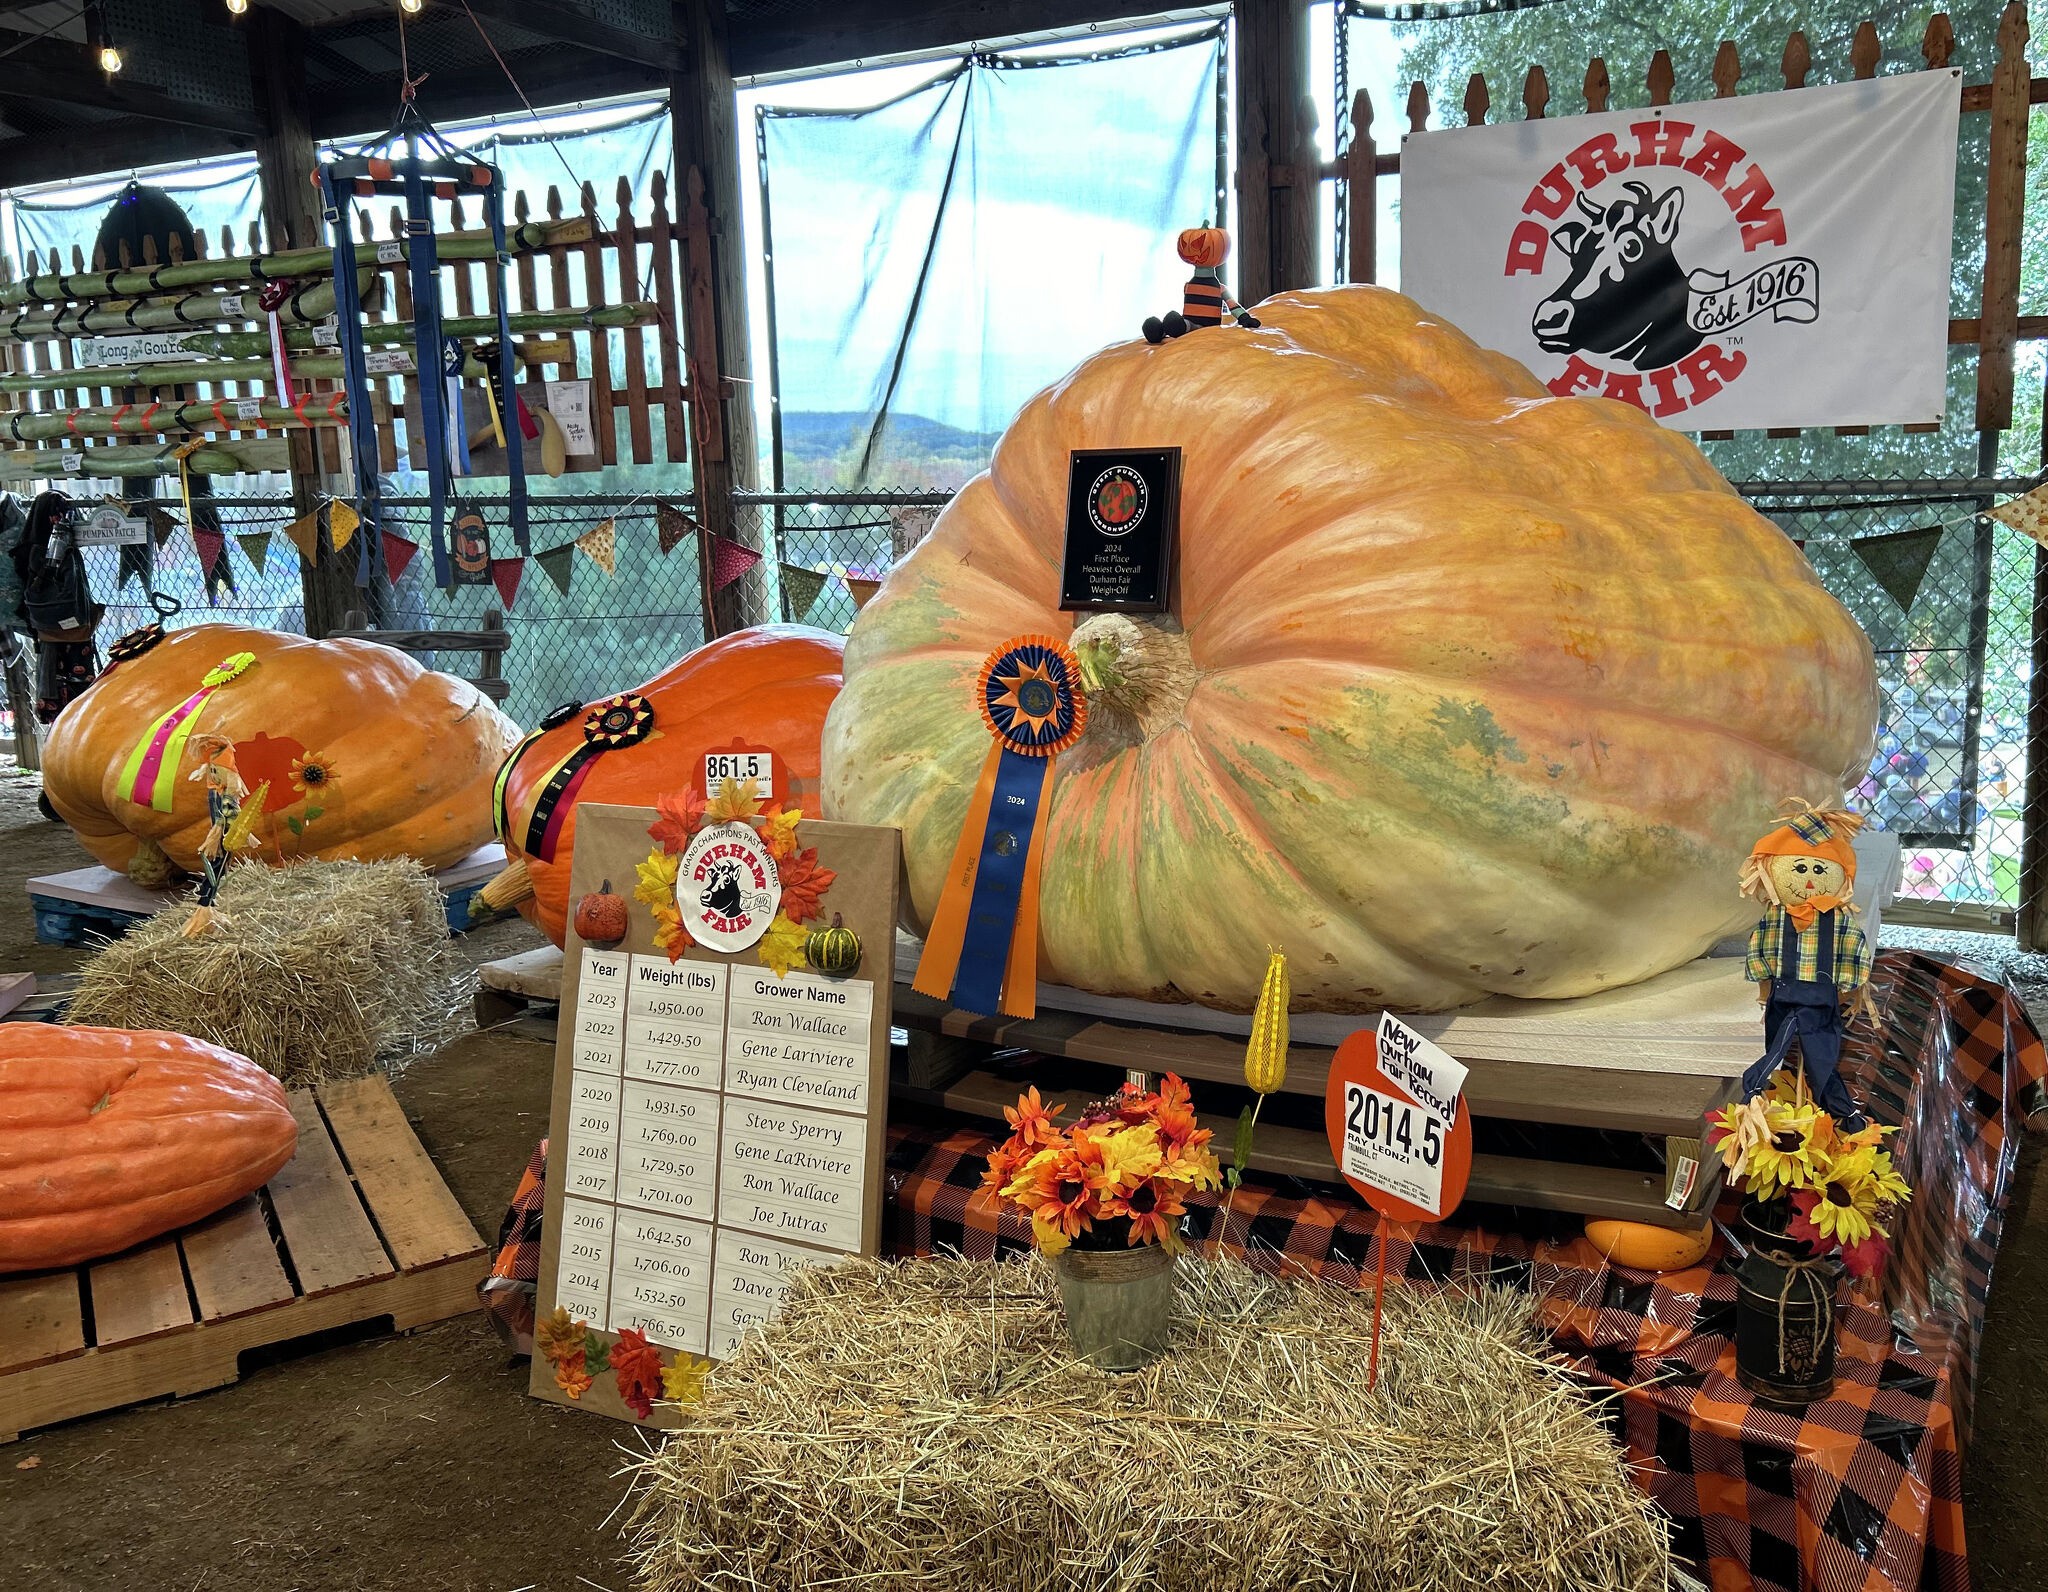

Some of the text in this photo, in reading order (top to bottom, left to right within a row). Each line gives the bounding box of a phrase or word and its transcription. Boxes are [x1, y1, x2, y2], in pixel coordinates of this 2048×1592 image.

[1504, 120, 1788, 276] DURHAM
[1693, 262, 1807, 330] Est 1916
[100, 345, 128, 360] Long
[1726, 337, 1744, 346] TM
[1546, 343, 1748, 418] FAIR
[1092, 469, 1145, 495] GREAT PUMPKIN
[82, 527, 136, 539] PUMPKIN PATCH
[1091, 508, 1143, 532] COMMONWEALTH
[1094, 555, 1130, 563] First Place
[1104, 544, 1122, 553] 2024
[1082, 565, 1141, 574] Heaviest Overall
[1089, 576, 1131, 584] Durham Fair
[1091, 586, 1129, 596] Weigh-Off
[707, 756, 759, 778] 861.5
[1007, 795, 1025, 806] 2024
[682, 829, 780, 888] GRAND CHAMPIONS PAST WINNERS
[694, 844, 767, 890] DURHAM
[701, 909, 752, 934] FAIR
[591, 960, 846, 1005] Year Weight (lbs) Grower Name
[587, 992, 848, 1037] 2023 1,950.00 Ron Wallace
[584, 1021, 855, 1069] 2022 1,429.50 Gene Lariviere
[1383, 1018, 1421, 1054] New
[583, 1050, 861, 1101] 2021 1,777.00 Ryan Cleveland
[1380, 1038, 1433, 1086] Durham
[1382, 1055, 1457, 1129] Fair Record!
[581, 1086, 843, 1147] 2020 1,931.50 Steve Sperry
[1347, 1087, 1441, 1167] 2014.5
[579, 1116, 852, 1176] 2019 1,769.00 Gene LaRiviere
[1347, 1132, 1368, 1147] RAY
[1372, 1143, 1410, 1165] LEONZI
[1348, 1141, 1378, 1160] TRUMBULL, CT
[578, 1145, 840, 1205] 2018 1,729.50 Ron Wallace
[576, 1174, 828, 1234] 2017 1,701.00 Joe Jutras
[573, 1213, 605, 1230] 2016
[635, 1227, 692, 1247] 1,642.50
[738, 1247, 770, 1268] Ron
[568, 1272, 600, 1291] 2014
[633, 1286, 686, 1308] 1,532.50
[571, 1243, 603, 1262] 2015
[633, 1256, 691, 1278] 1,706.00
[732, 1277, 773, 1298] Dave
[568, 1302, 685, 1338] 2013 1,766.50
